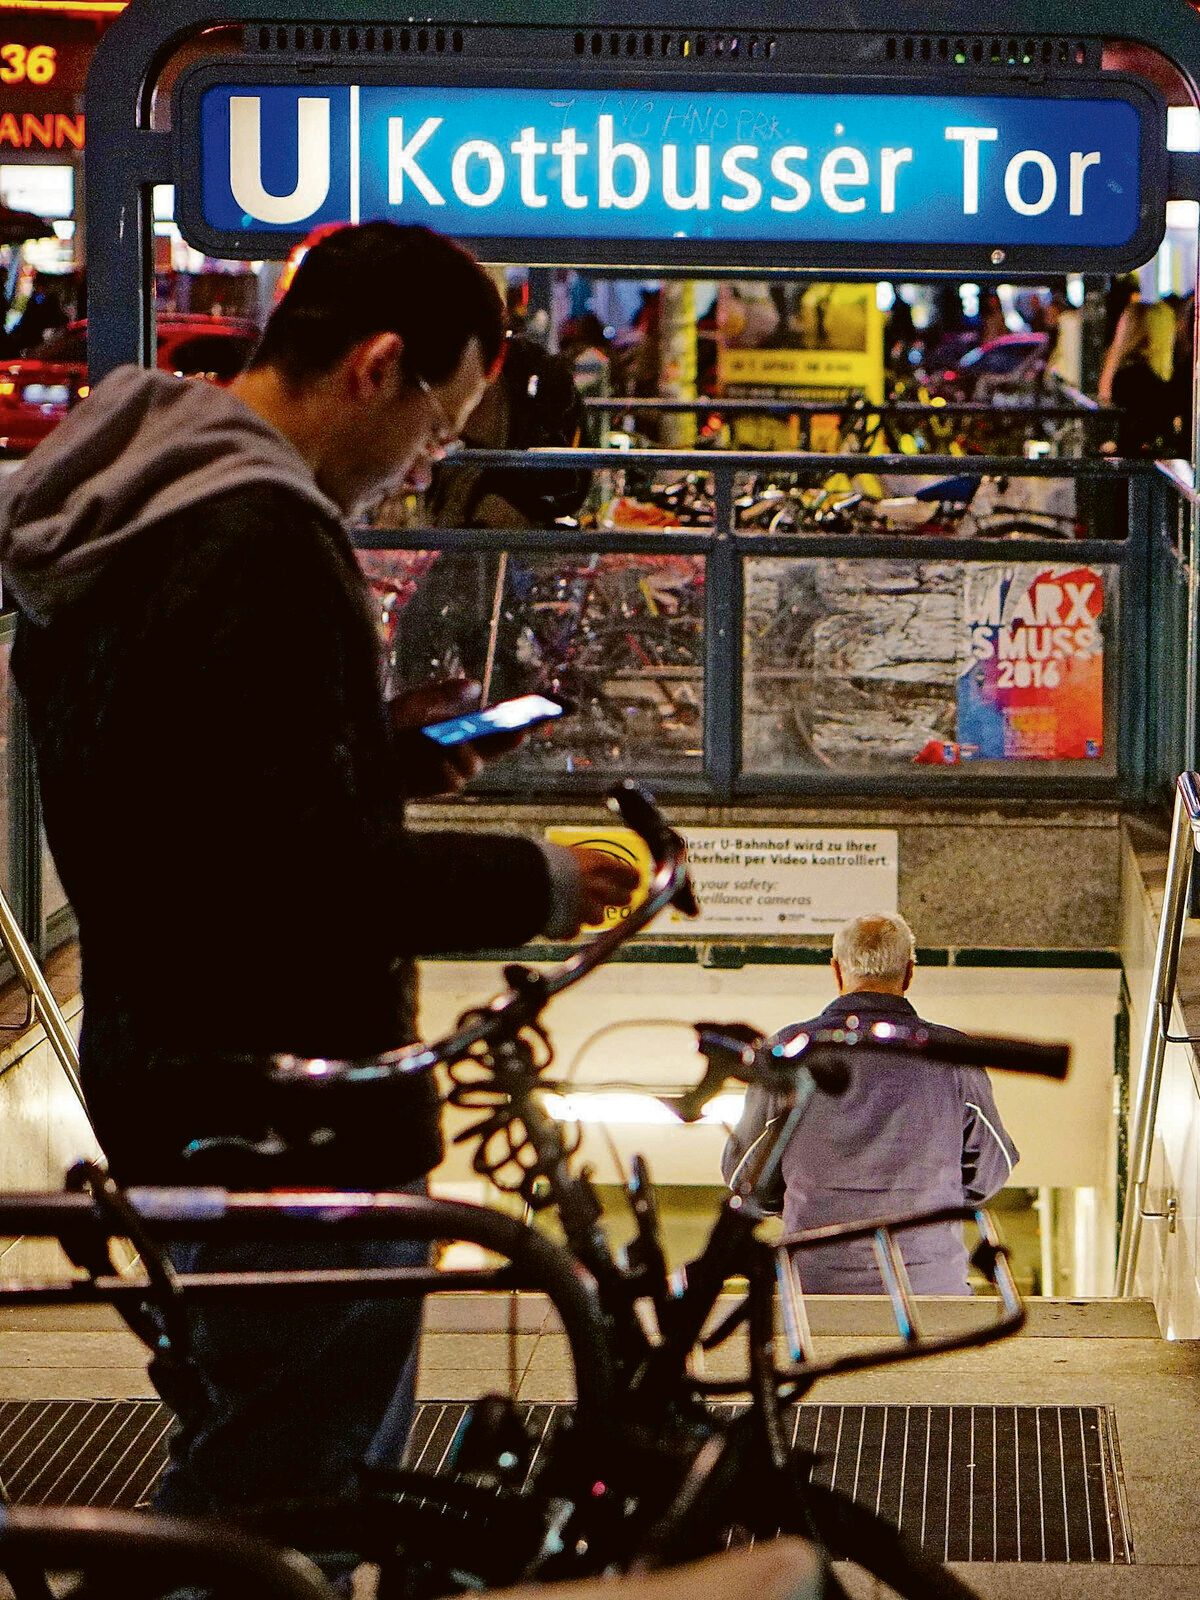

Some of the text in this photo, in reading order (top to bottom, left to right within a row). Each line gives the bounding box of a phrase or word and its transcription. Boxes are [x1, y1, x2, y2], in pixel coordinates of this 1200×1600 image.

[0, 44, 57, 85] 36
[230, 96, 331, 225] U
[387, 114, 913, 214] Kottbusser
[944, 126, 1101, 216] Tor
[996, 660, 1061, 689] 2016
[686, 838, 877, 851] ieser U-Bahnhof wird zu Ihrer
[687, 852, 741, 865] cherheit
[744, 854, 766, 867] per
[769, 853, 808, 866] Video
[700, 881, 729, 892] your
[757, 895, 813, 906] cameras
